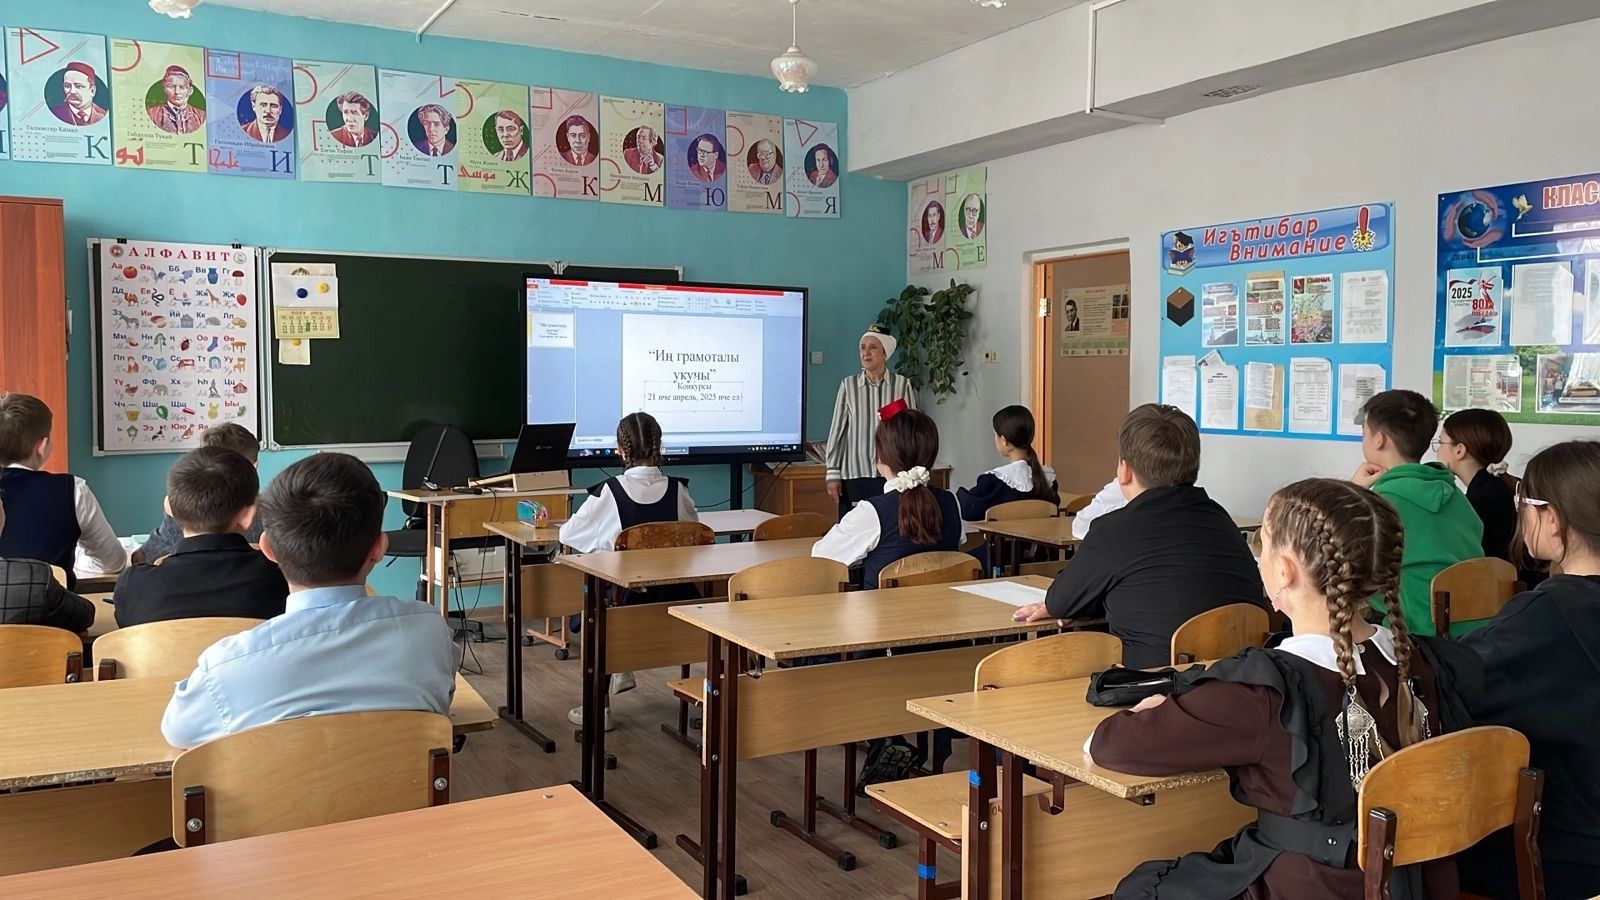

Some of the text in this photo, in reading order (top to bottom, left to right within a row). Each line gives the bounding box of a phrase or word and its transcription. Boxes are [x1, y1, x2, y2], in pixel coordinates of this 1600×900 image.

[84, 135, 109, 159] К
[184, 142, 204, 165] Т
[270, 150, 293, 173] И
[360, 154, 379, 176] Т
[437, 164, 454, 185] Т
[582, 176, 598, 196] К
[643, 182, 662, 202] М
[705, 188, 725, 206] Ю
[766, 192, 782, 210] М
[1543, 181, 1600, 210] КЛАС
[824, 196, 837, 214] Я
[1203, 216, 1320, 246] Игътибар
[128, 247, 230, 261] АЛФАВИТ
[976, 246, 984, 262] Е
[1229, 234, 1347, 263] Внимание
[112, 262, 122, 270] Аа
[196, 266, 206, 274] Вв
[932, 251, 944, 270] М
[1452, 288, 1472, 298] 2025
[112, 308, 122, 316] Зз
[677, 352, 739, 364] грамоталы
[142, 378, 157, 386] Фф
[224, 378, 235, 386] Цц
[677, 382, 712, 392] Конкурсы
